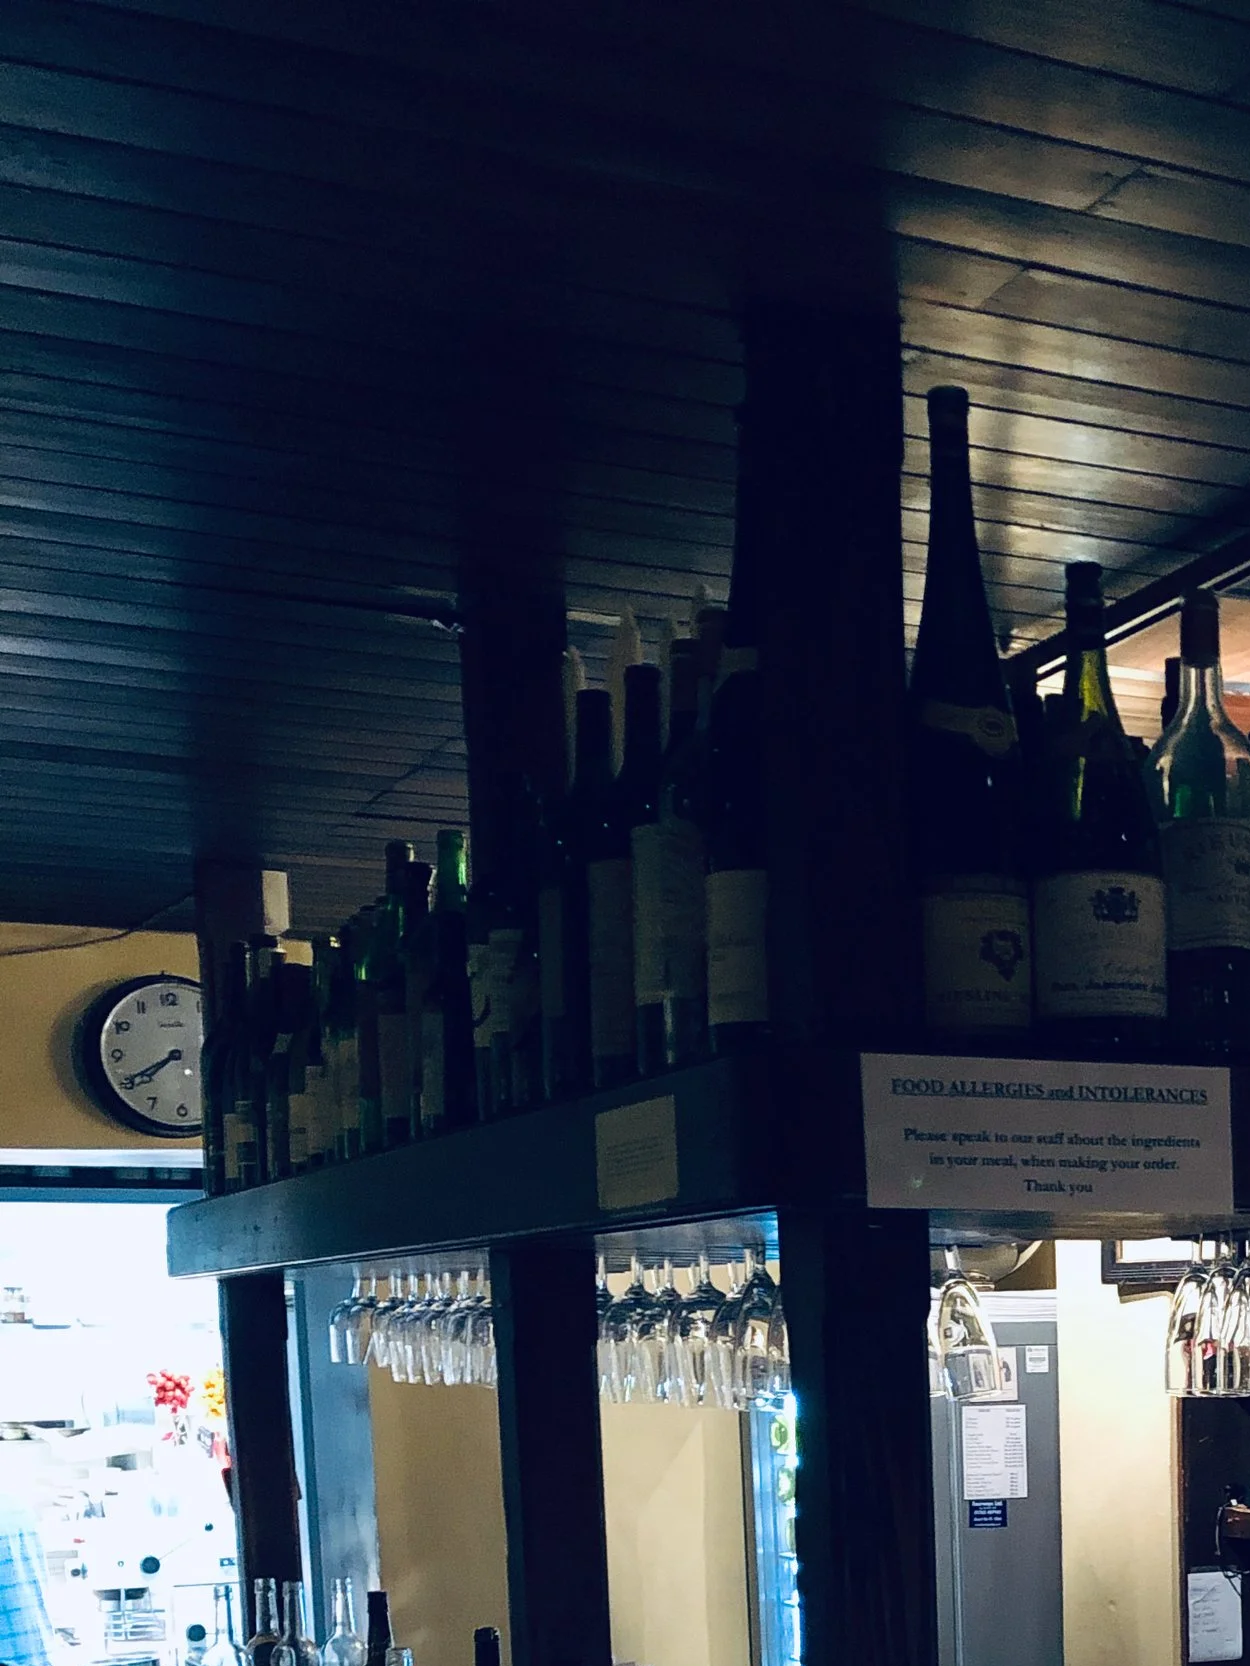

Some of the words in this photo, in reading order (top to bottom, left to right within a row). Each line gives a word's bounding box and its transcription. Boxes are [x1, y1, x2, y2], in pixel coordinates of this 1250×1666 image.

[160, 993, 178, 1006] 12
[137, 1001, 146, 1014] 11
[114, 1020, 131, 1034] 10
[111, 1048, 123, 1063] 9
[891, 1078, 944, 1095] FOOD
[949, 1080, 1045, 1098] ALLERGIES
[1048, 1086, 1074, 1099] and
[1078, 1085, 1208, 1104] INTOLERANCES
[146, 1096, 158, 1111] 7
[176, 1104, 188, 1117] 6
[904, 1127, 947, 1142] Please
[951, 1130, 990, 1146] speak
[995, 1131, 1008, 1143] to
[1012, 1134, 1033, 1143] our
[1036, 1132, 1064, 1145] staff
[1067, 1133, 1103, 1146] about
[1107, 1134, 1128, 1146] the
[1131, 1134, 1200, 1151] ingredients
[929, 1152, 944, 1165] in
[947, 1156, 978, 1169] your
[982, 1154, 1017, 1169] meal,
[1021, 1154, 1055, 1168] when
[1058, 1156, 1108, 1172] making
[1111, 1160, 1140, 1172] your
[1143, 1158, 1180, 1170] order.
[1023, 1179, 1066, 1193] Thank
[1068, 1183, 1093, 1198] you
